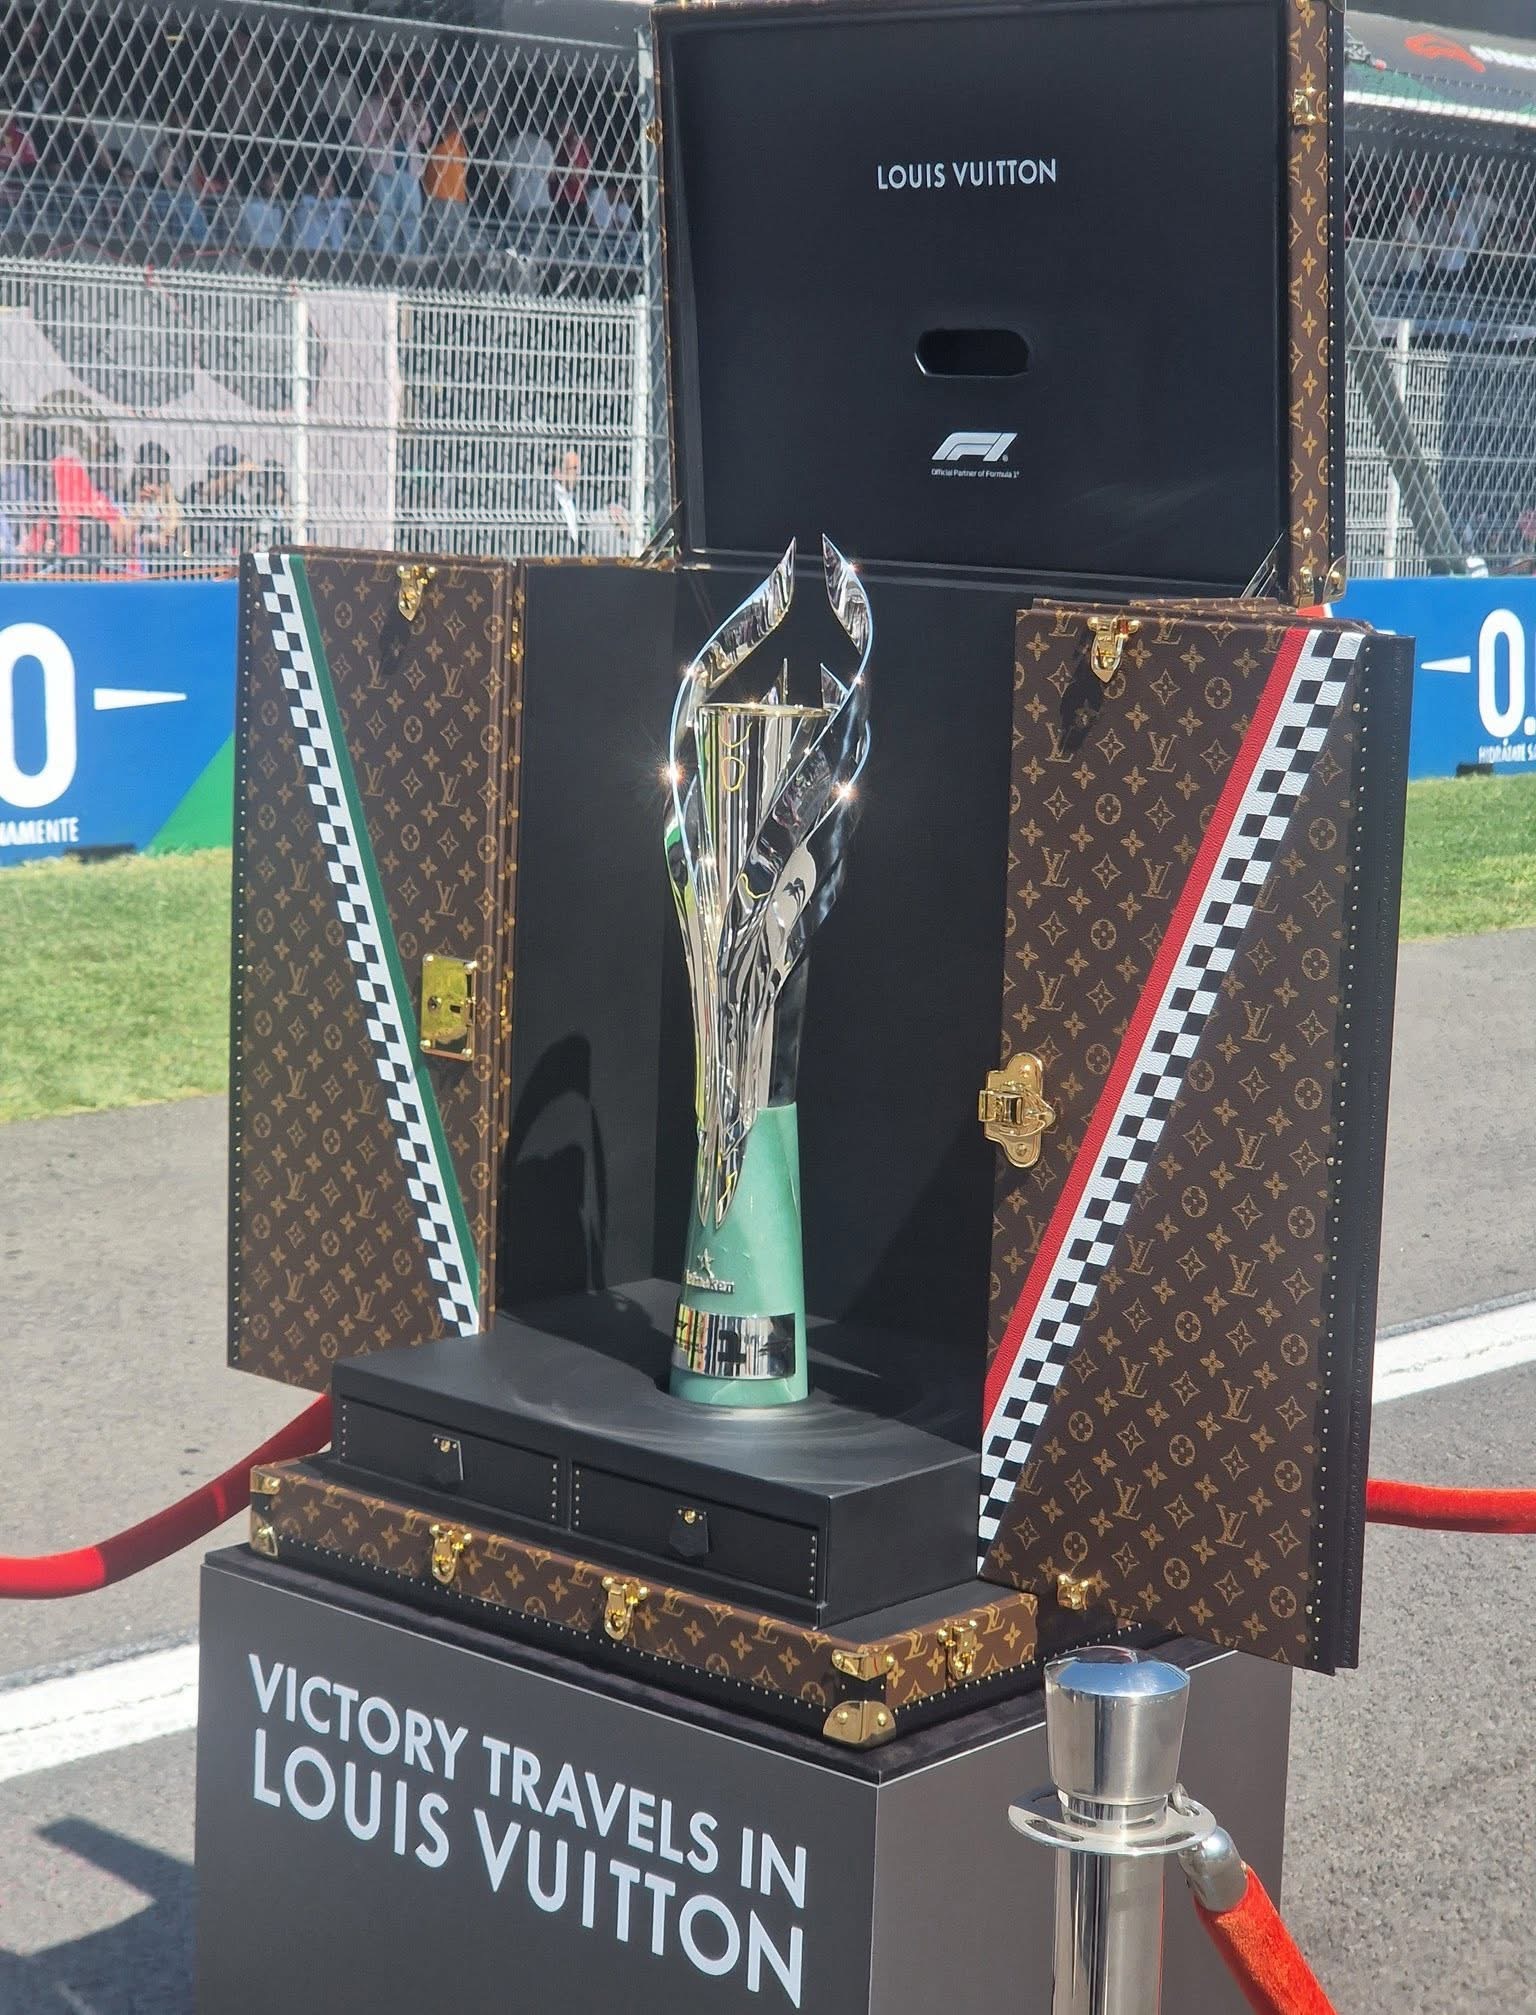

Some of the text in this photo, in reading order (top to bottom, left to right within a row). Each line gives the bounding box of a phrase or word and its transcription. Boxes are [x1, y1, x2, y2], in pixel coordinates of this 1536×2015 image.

[877, 158, 1057, 190] LOUIS VUITTON
[953, 469, 977, 477] Partner
[977, 469, 986, 478] of
[985, 470, 1013, 479] Formula
[1478, 608, 1536, 738] 0.
[248, 1653, 806, 1909] VICTORY TRAVELS IN
[253, 1728, 804, 2009] LOUIS VUITTON
